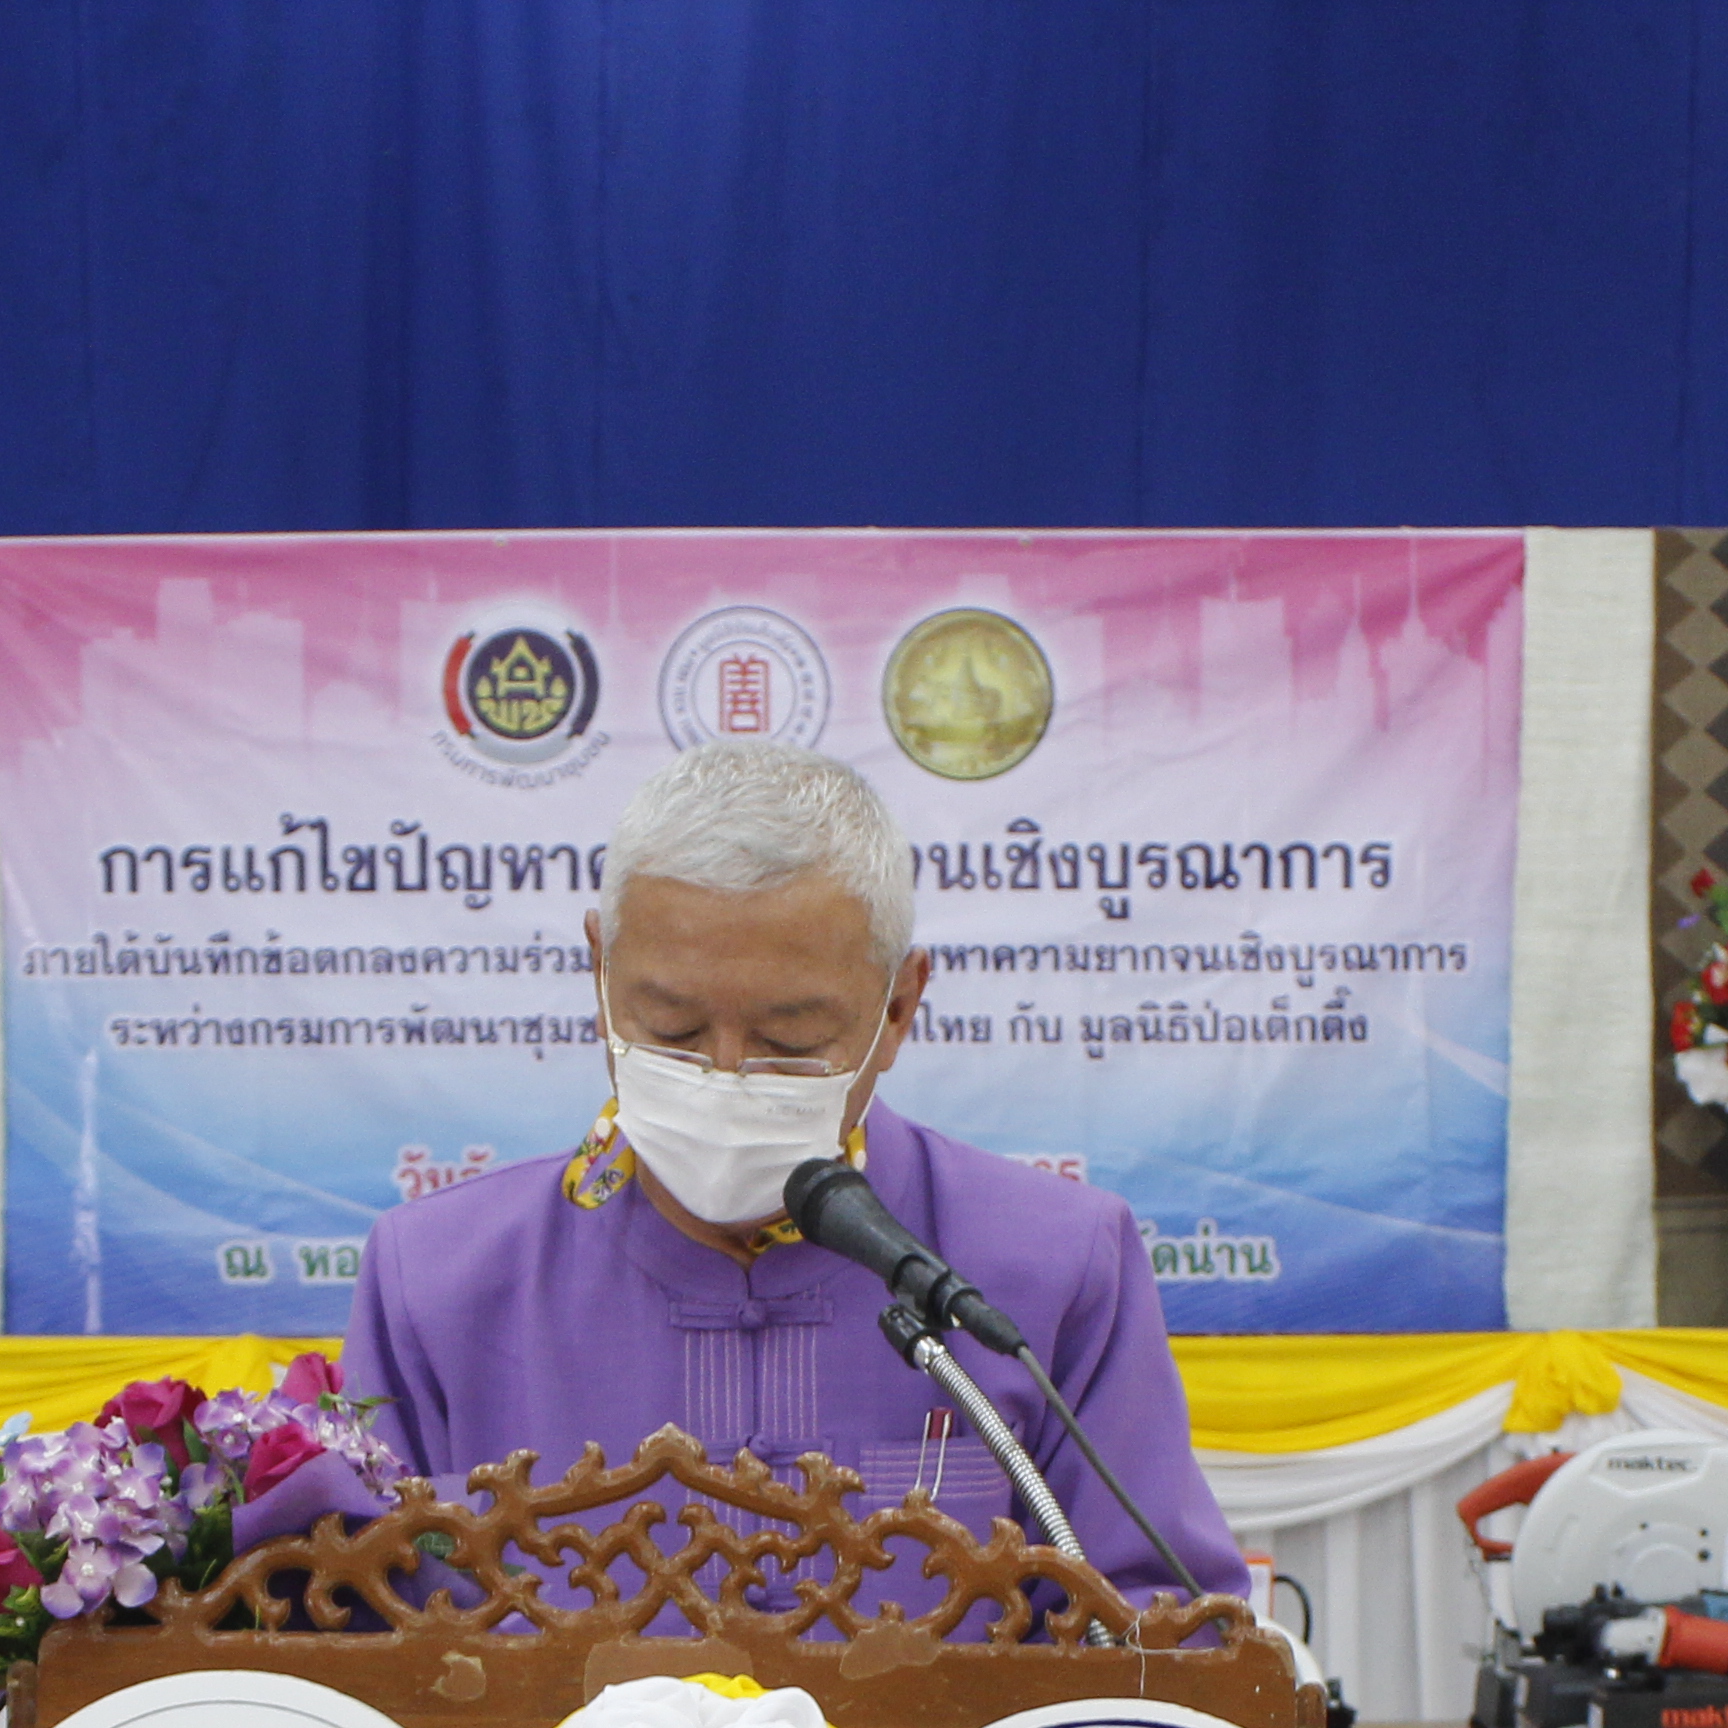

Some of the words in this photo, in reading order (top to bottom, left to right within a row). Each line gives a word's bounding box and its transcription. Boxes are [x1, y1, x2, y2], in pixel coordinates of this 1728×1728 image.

[929, 929, 1469, 988] หาความยากจนเชิงบูรณาการ
[1008, 1001, 1063, 1043] กับ
[225, 1246, 268, 1278] ณ
